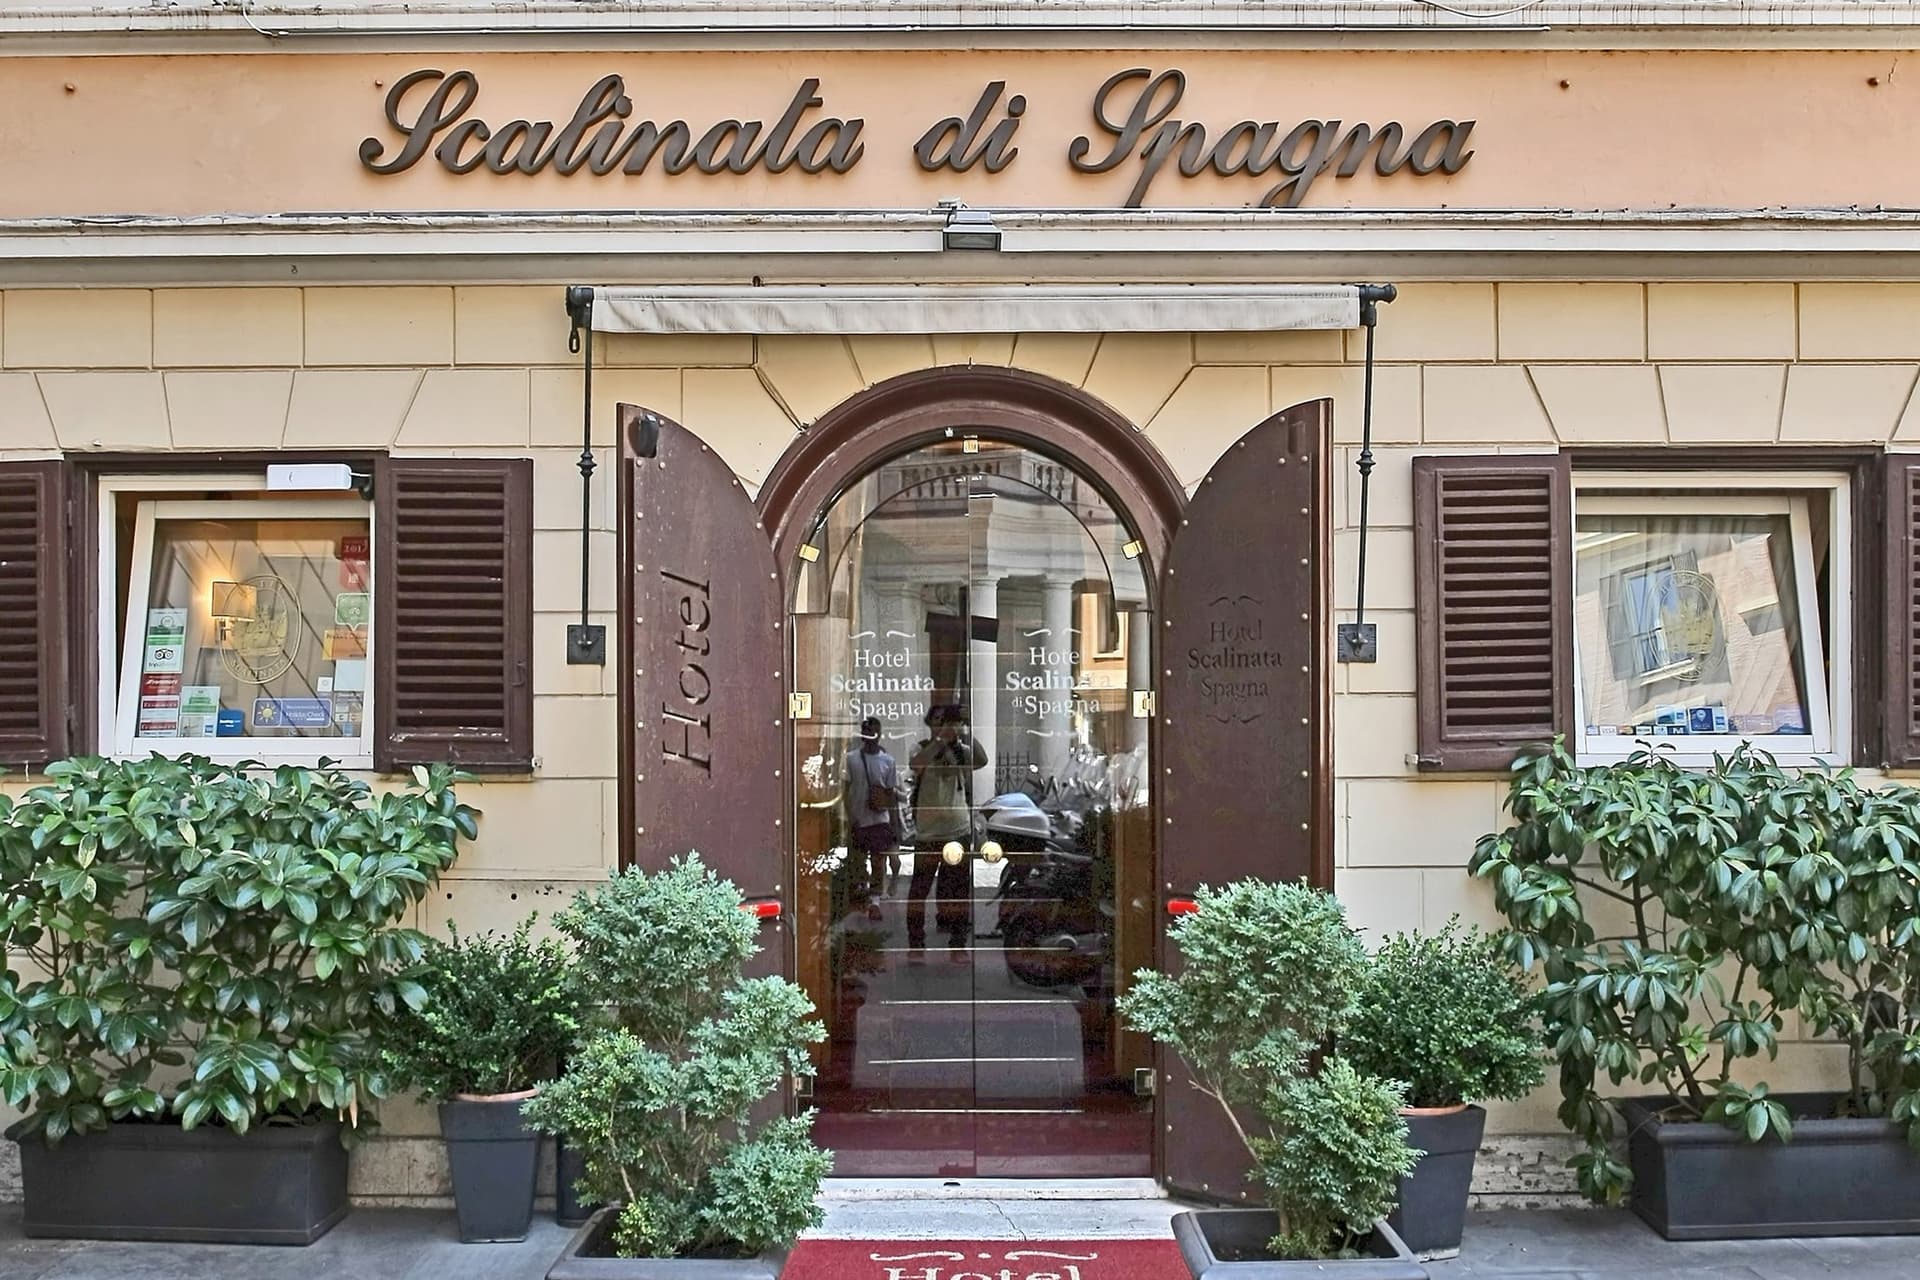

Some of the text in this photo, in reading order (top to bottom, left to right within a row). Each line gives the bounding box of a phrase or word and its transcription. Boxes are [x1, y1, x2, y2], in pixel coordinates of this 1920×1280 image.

[358, 67, 1477, 208] Scalinata di Spagna
[1209, 619, 1263, 642] Hotel
[854, 647, 911, 668] Hotel
[1029, 646, 1085, 666] Hote
[1188, 647, 1283, 670] Scalinata
[660, 570, 711, 778] Hotel
[831, 672, 935, 693] Scalinata
[1201, 675, 1270, 705] Spagna
[849, 697, 924, 721] Spagna
[1011, 695, 1102, 720] di Spagna
